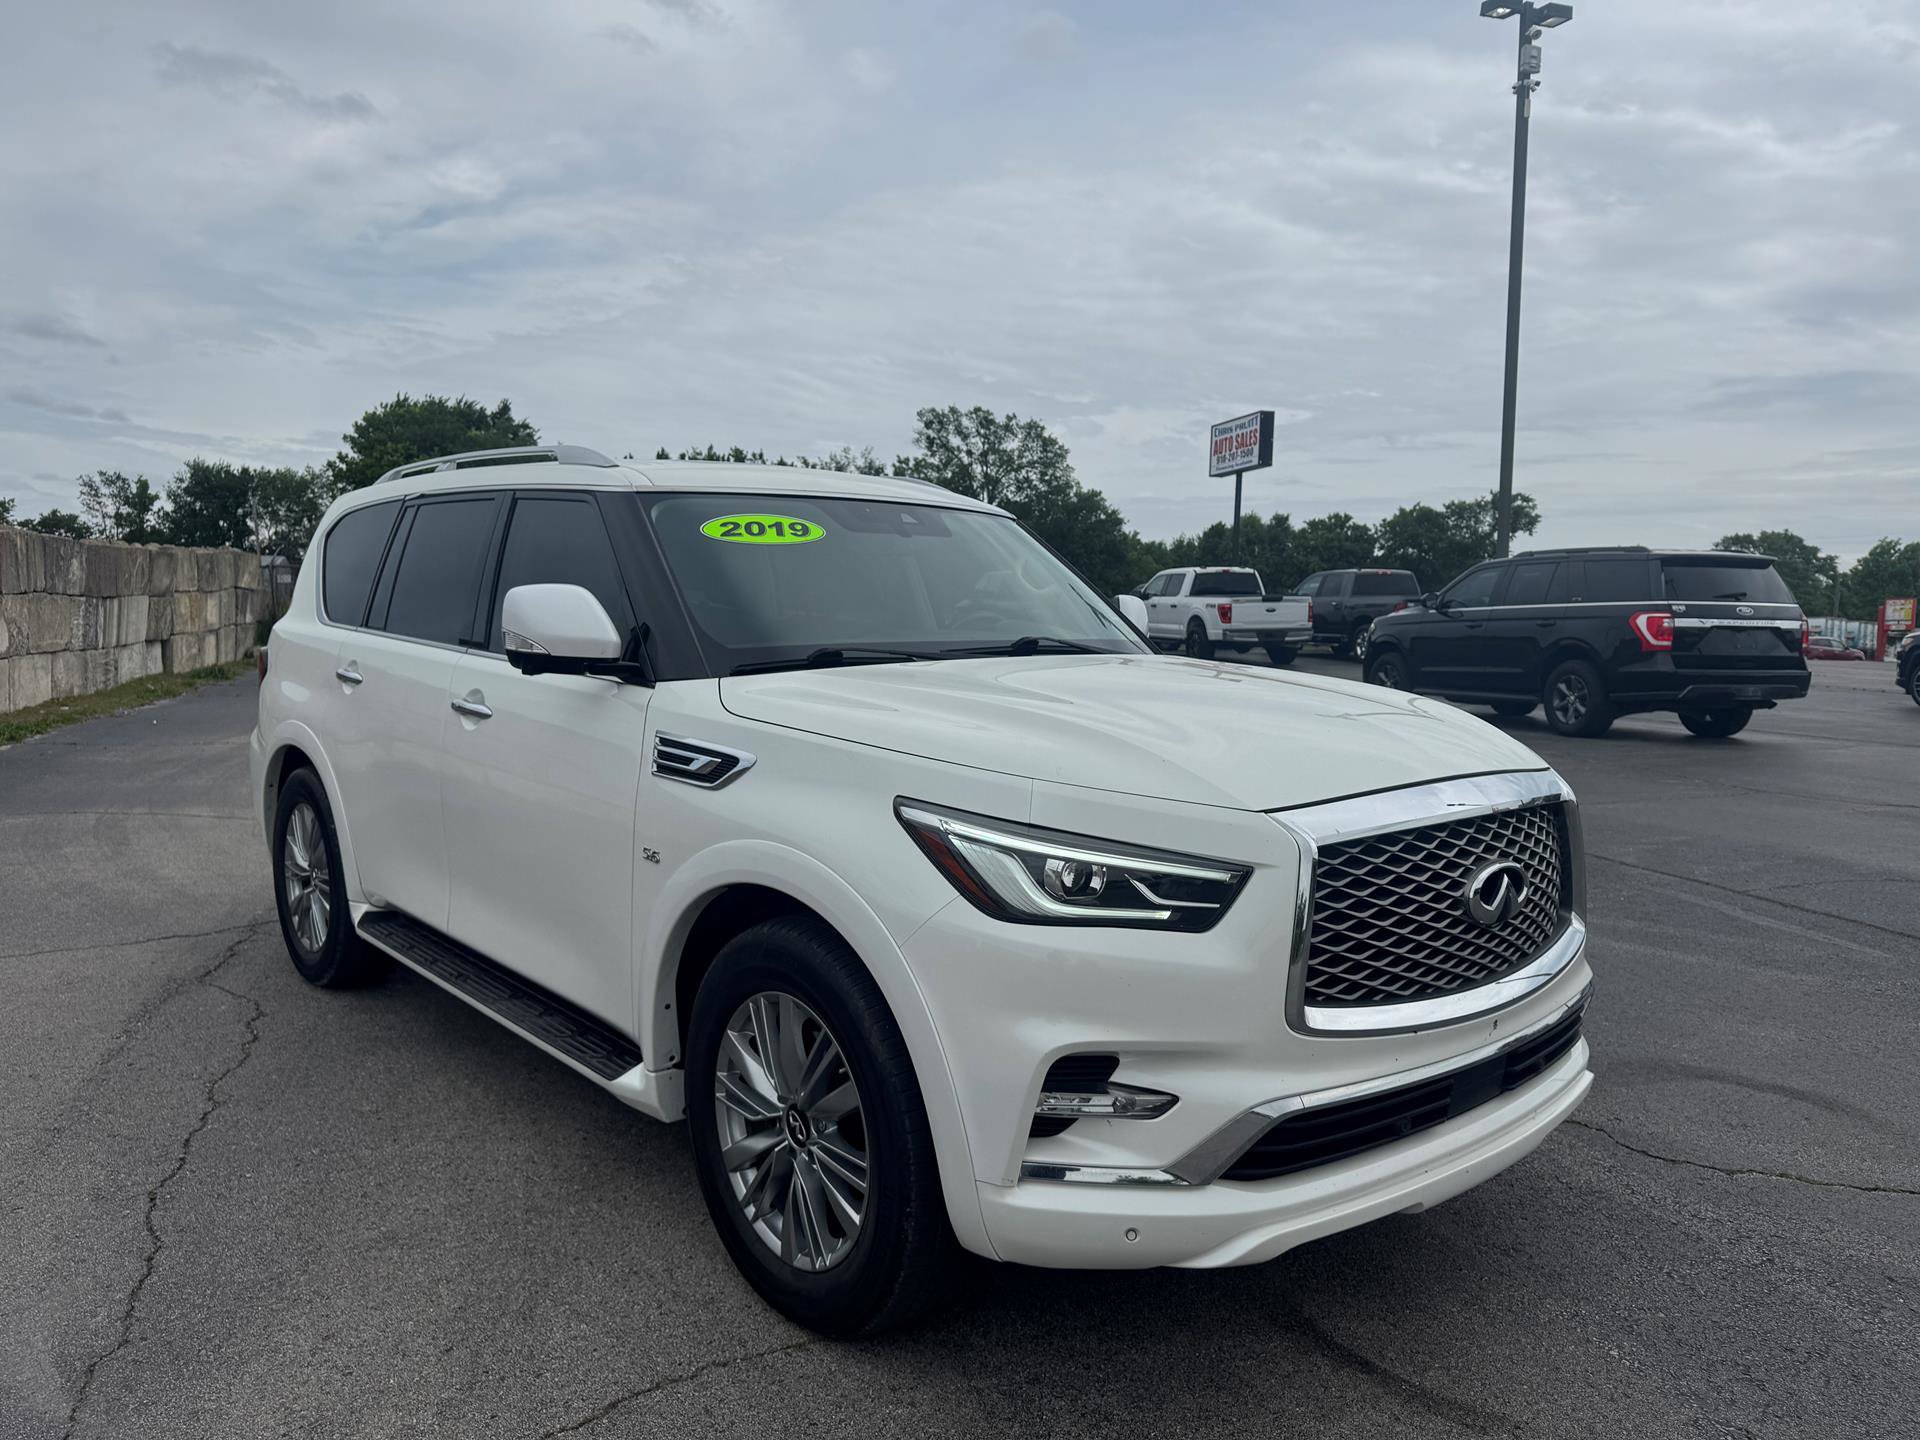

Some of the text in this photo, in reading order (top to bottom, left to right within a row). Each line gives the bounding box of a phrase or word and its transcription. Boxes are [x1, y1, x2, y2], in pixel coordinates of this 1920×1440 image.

[1213, 428, 1258, 456] AUTO SALES
[719, 521, 811, 537] 2019
